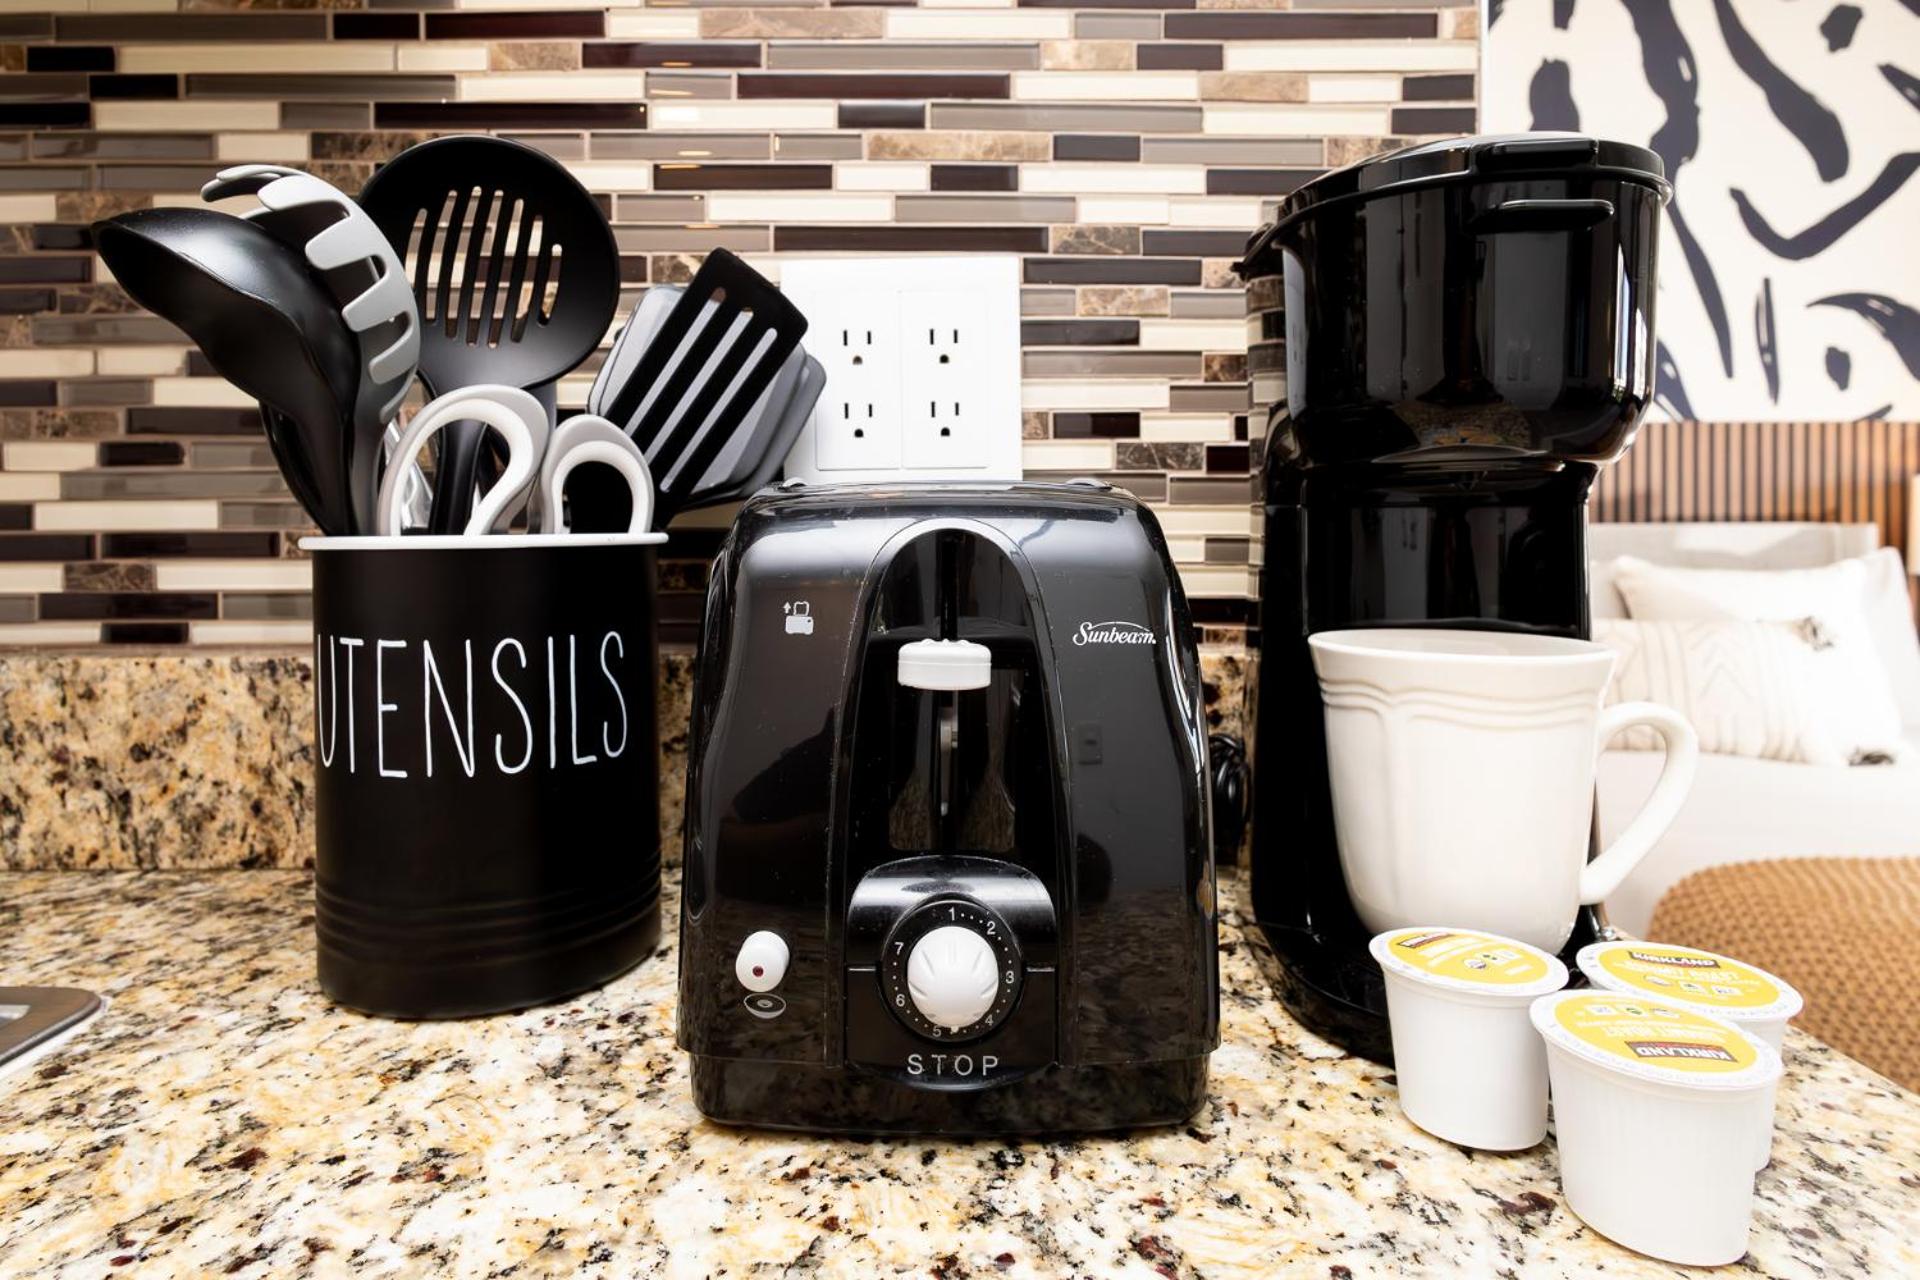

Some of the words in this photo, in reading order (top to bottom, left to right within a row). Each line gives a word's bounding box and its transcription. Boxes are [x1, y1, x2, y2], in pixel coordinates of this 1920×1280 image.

[1072, 621, 1156, 646] Sunbeam
[317, 631, 628, 777] UTENSILS
[948, 906, 957, 921] 1
[986, 920, 996, 935] 2
[894, 941, 905, 956] 7
[1631, 951, 1716, 968] KIRKLAND
[1005, 970, 1015, 984] 3
[895, 993, 906, 1007] 6
[984, 1014, 995, 1026] 4
[932, 1025, 942, 1038] 5
[1635, 1046, 1732, 1063] KIRKLAND
[906, 1053, 999, 1077] STOP
